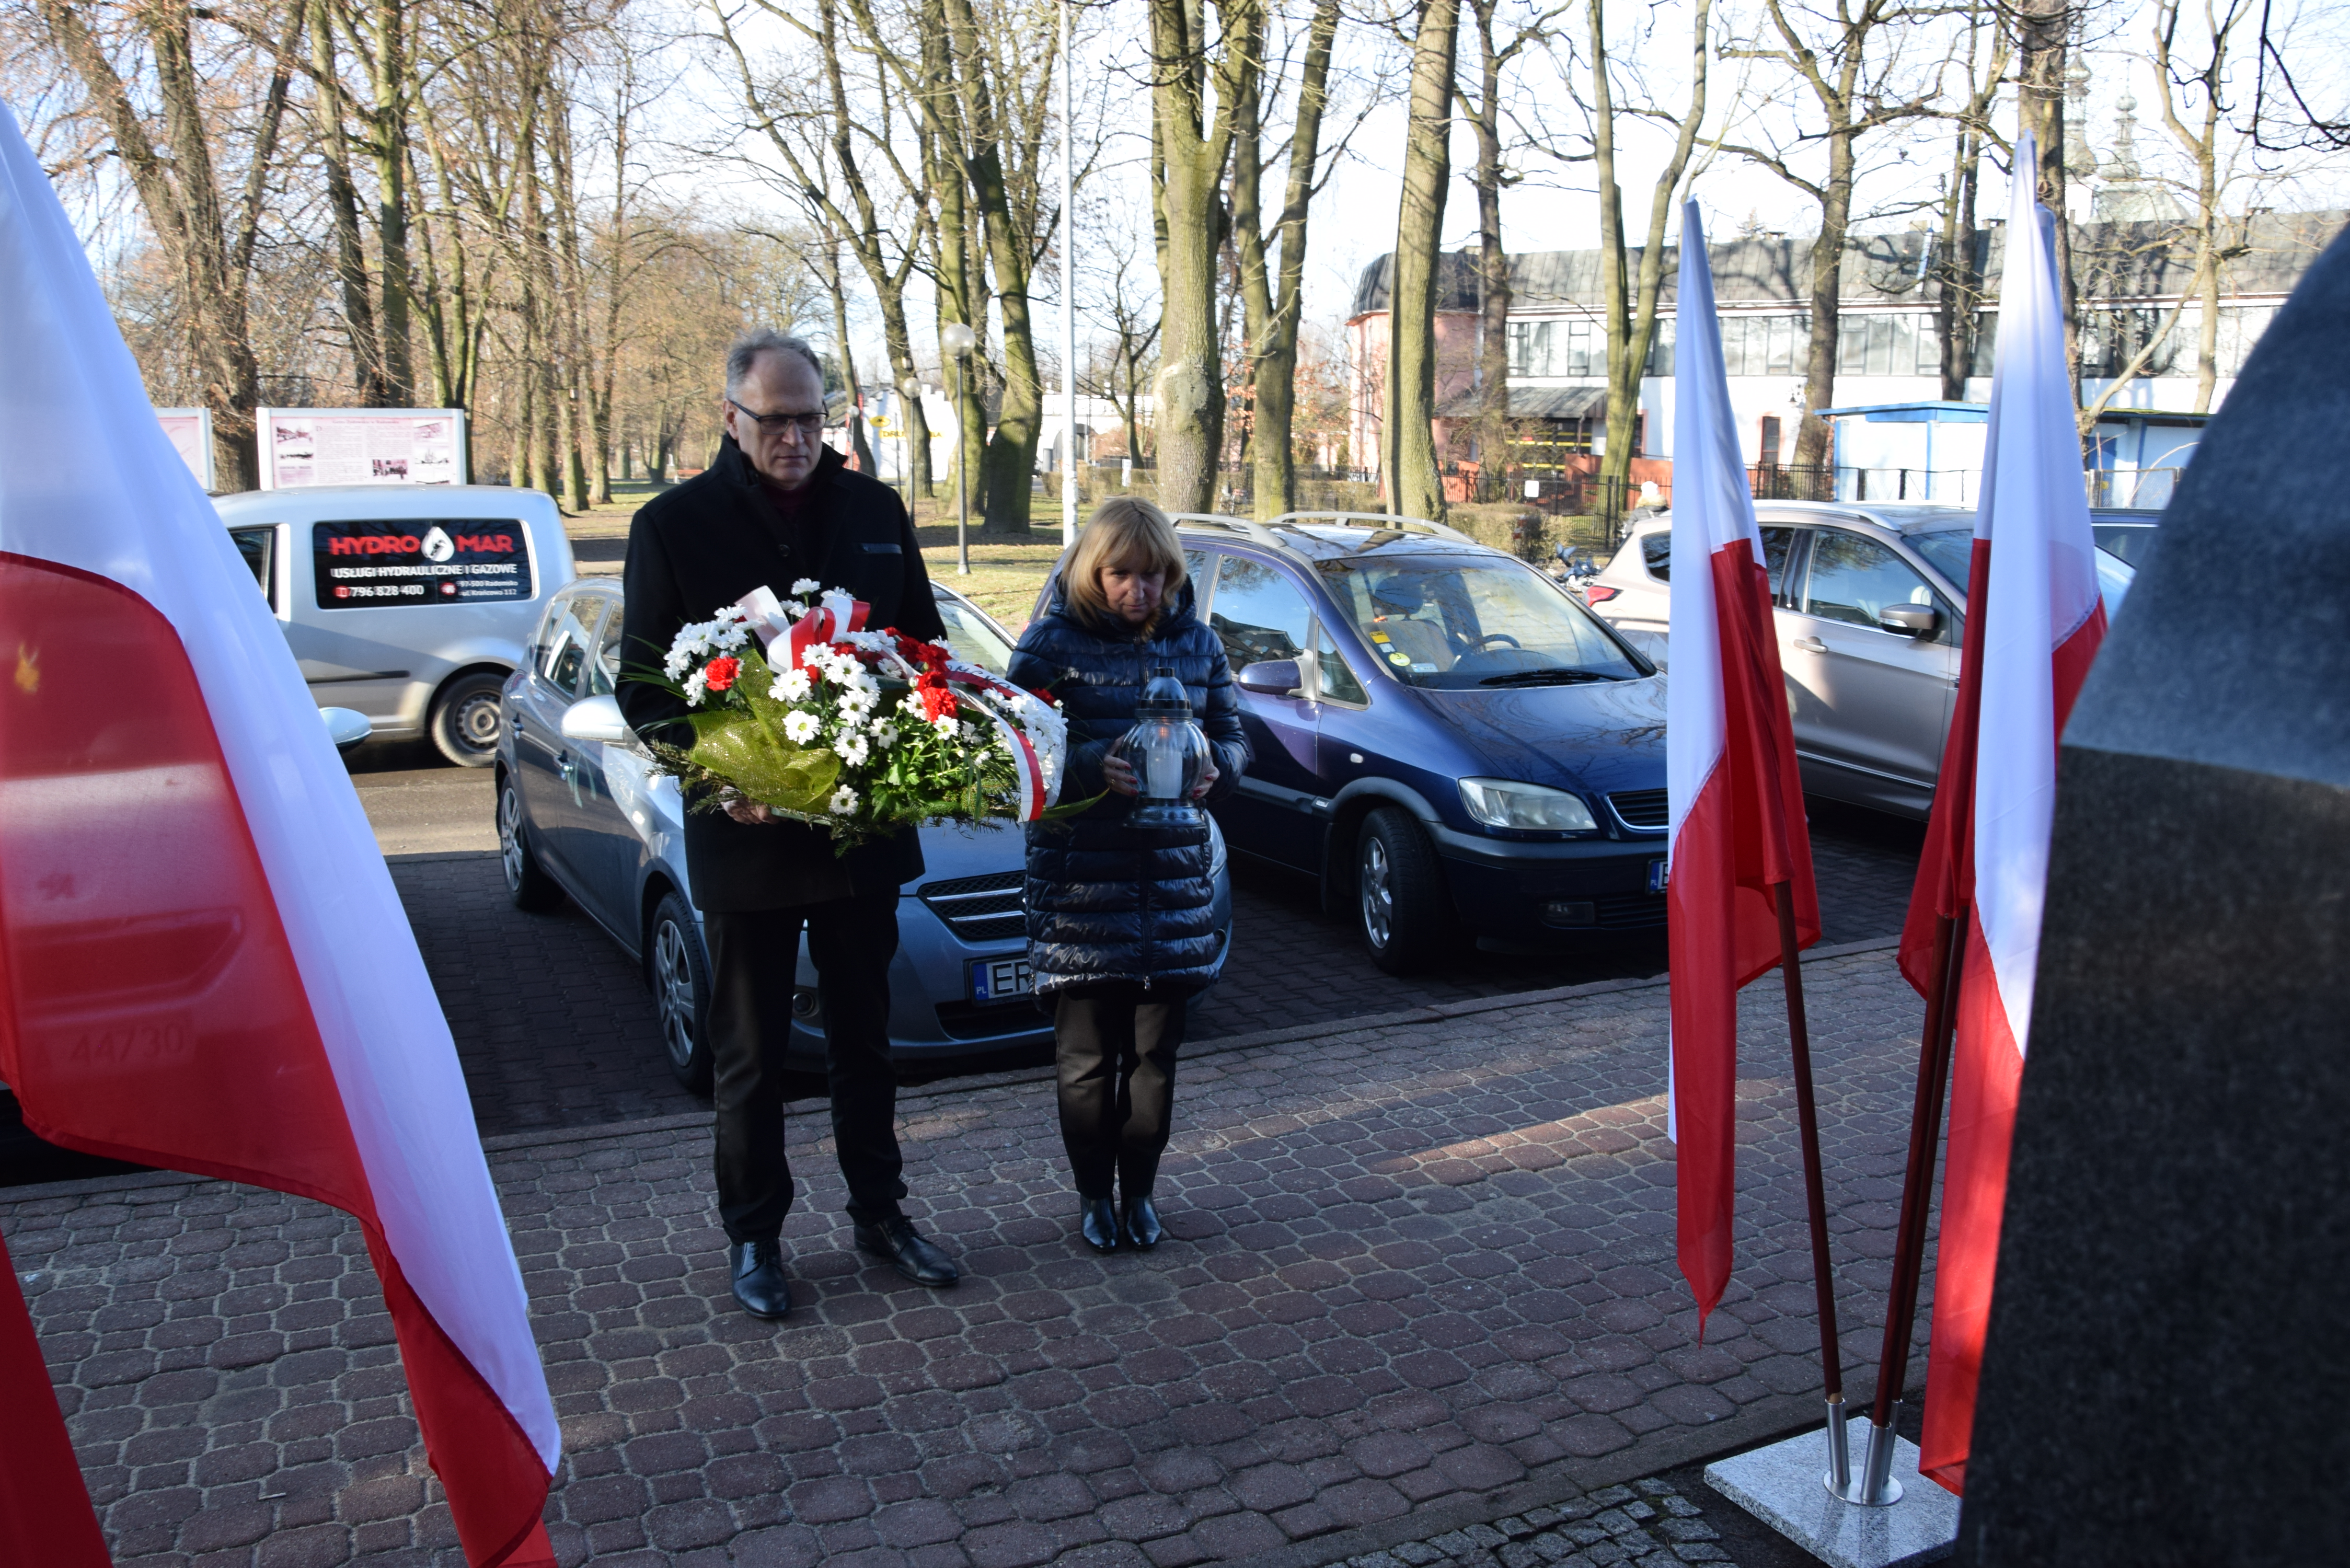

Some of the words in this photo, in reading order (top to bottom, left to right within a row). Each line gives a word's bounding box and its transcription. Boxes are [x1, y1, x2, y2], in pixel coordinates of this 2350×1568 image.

[328, 535, 421, 555] HYDRO
[454, 534, 515, 552] MAR
[330, 567, 376, 578] USŁUGI
[377, 565, 463, 577] HYDRAULICZNE
[464, 565, 469, 574] I
[470, 564, 517, 574] GAZOWE
[349, 586, 374, 597] 796
[374, 585, 399, 596] 828
[399, 584, 424, 595] 400
[976, 986, 987, 995] PL
